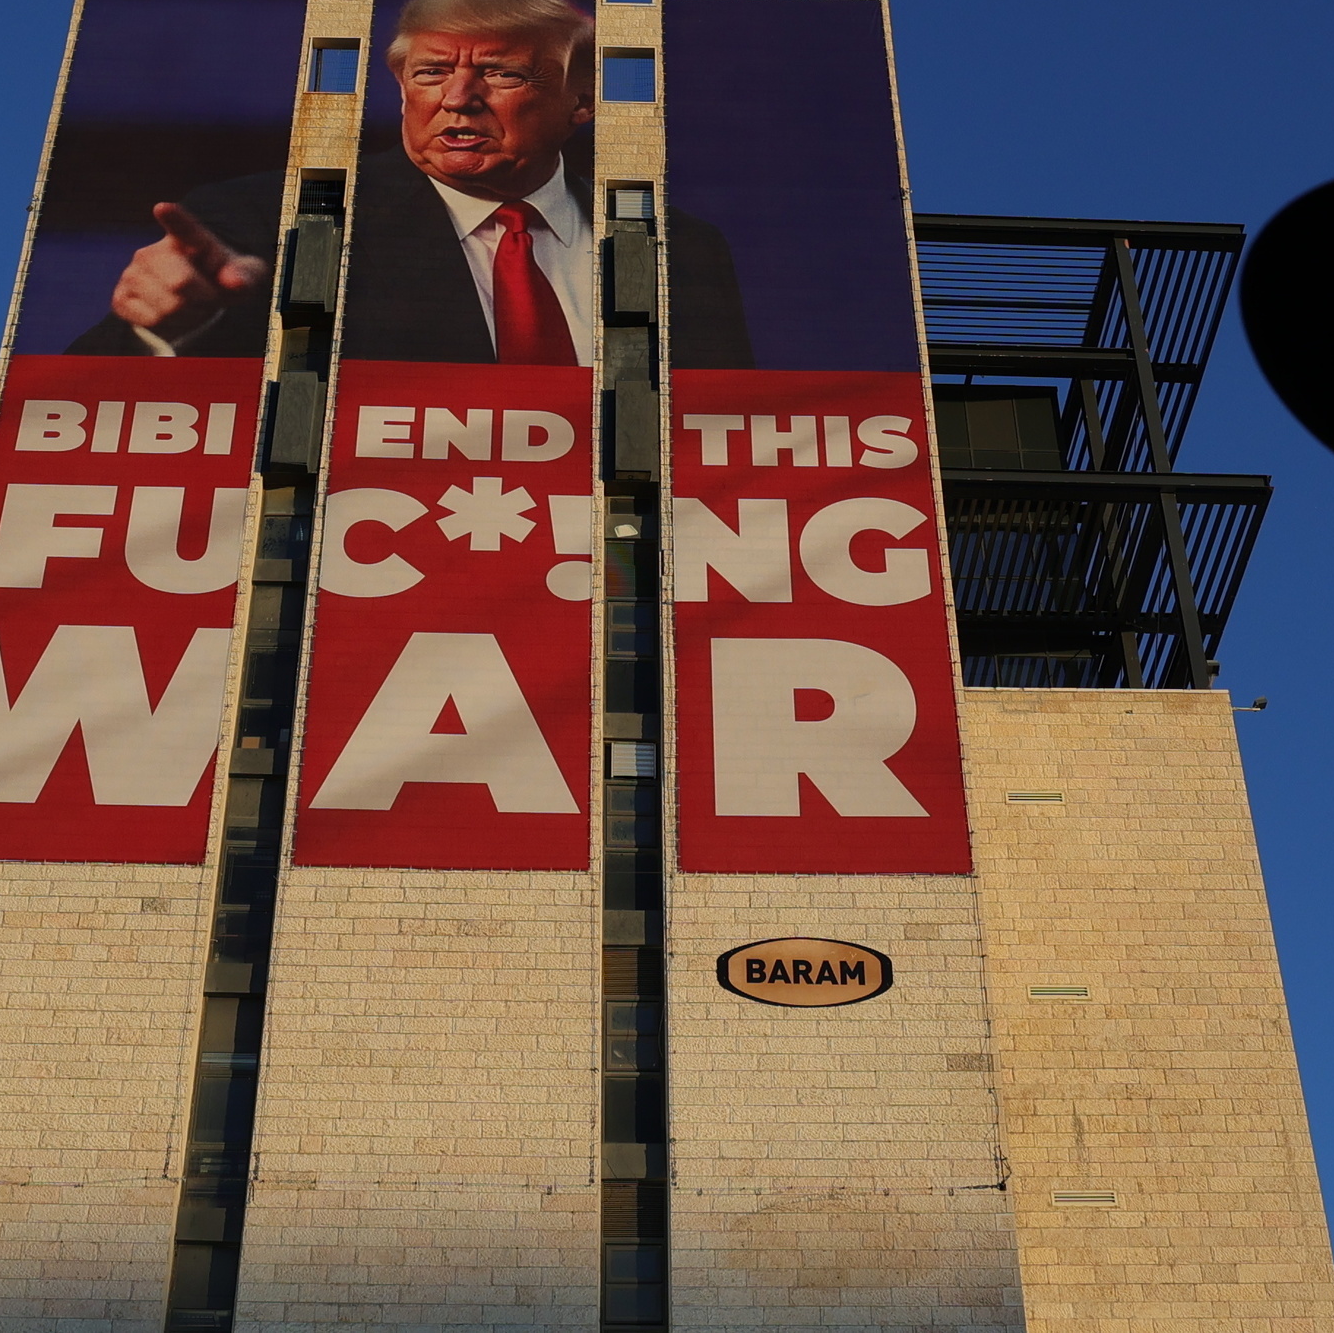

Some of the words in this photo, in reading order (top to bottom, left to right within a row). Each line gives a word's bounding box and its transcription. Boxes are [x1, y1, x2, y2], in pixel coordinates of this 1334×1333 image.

[14, 400, 237, 455] BIBI
[355, 405, 575, 462] END
[683, 414, 919, 469] THIS
[746, 958, 866, 986] BARAM
